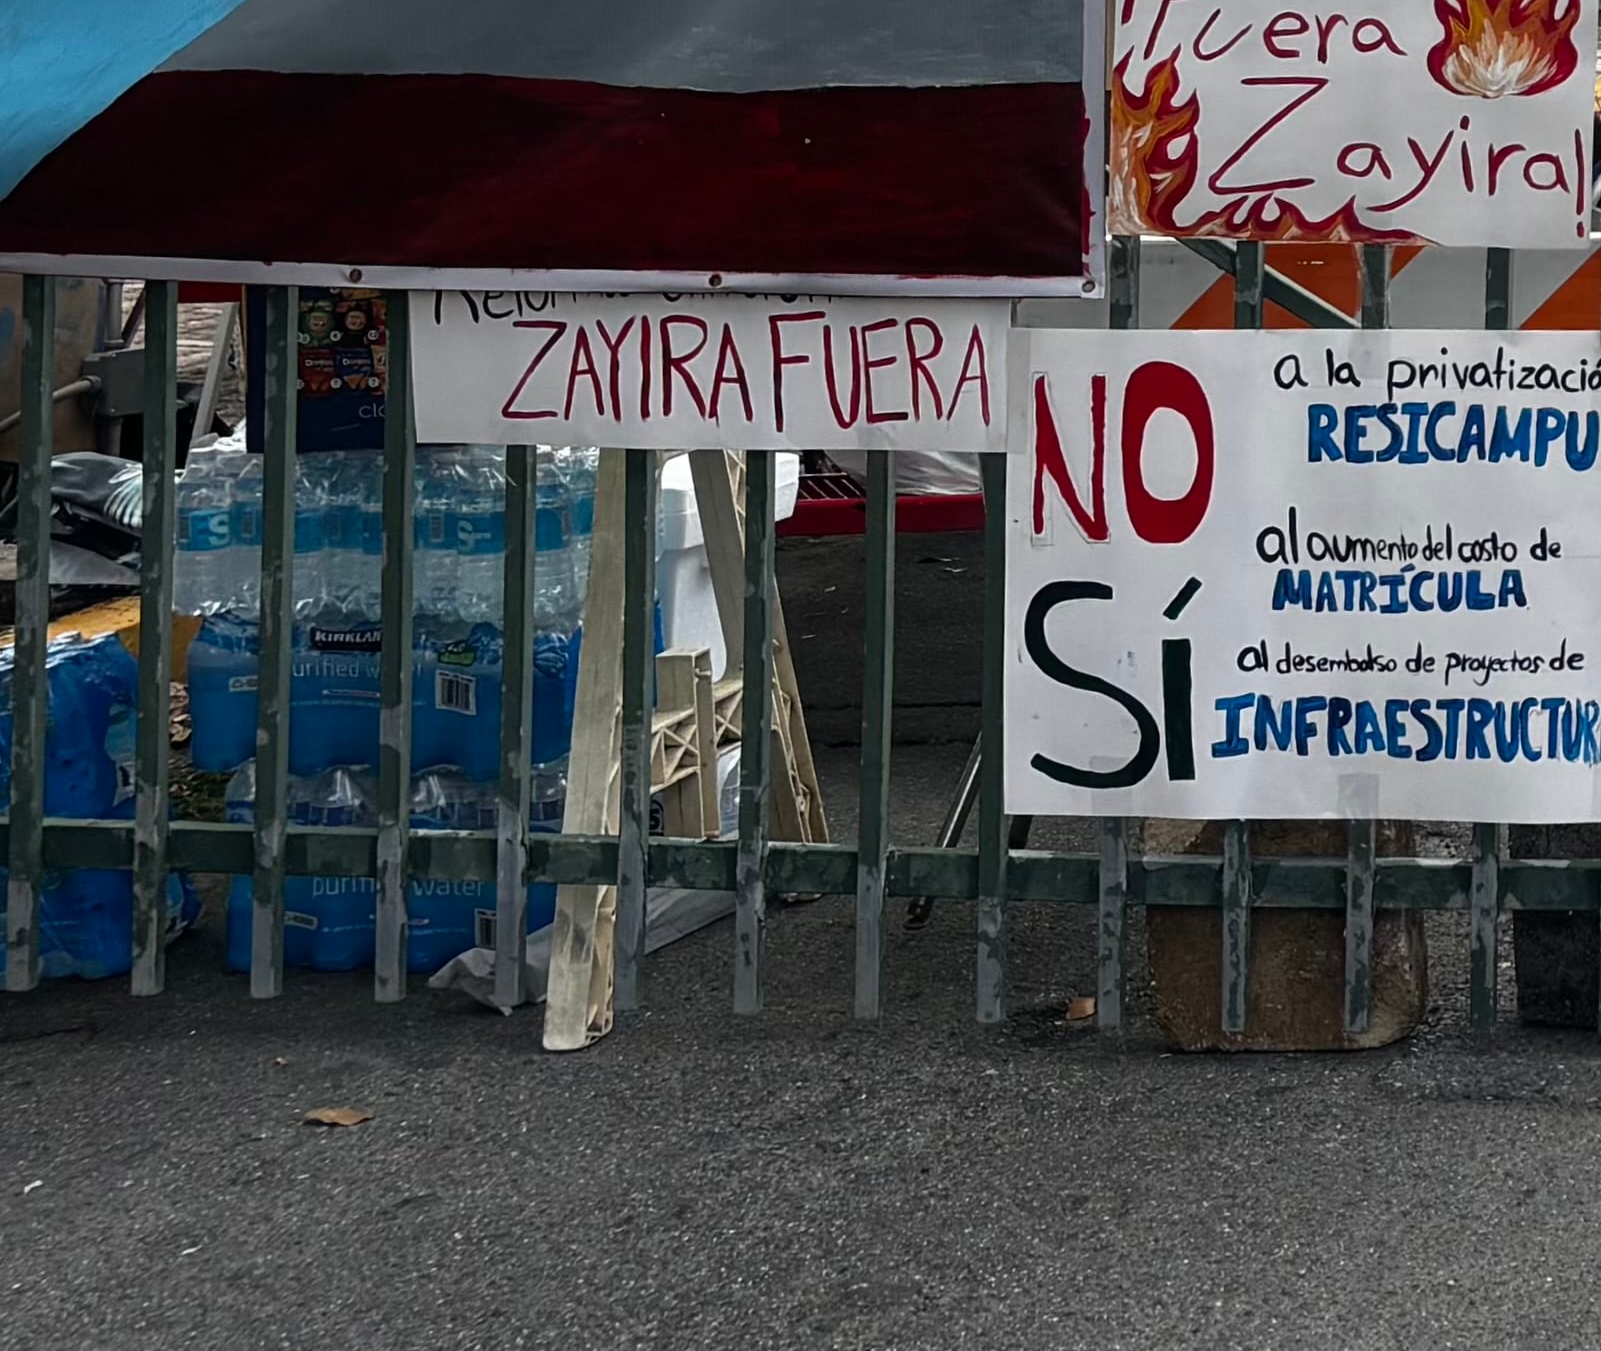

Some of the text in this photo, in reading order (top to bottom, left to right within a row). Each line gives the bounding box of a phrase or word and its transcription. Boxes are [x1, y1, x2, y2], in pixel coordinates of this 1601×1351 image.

[1208, 77, 1586, 238] Zayira!
[501, 310, 991, 432] ZAYIRA FUERA
[1273, 352, 1309, 390] a
[1327, 348, 1361, 388] la
[1032, 360, 1215, 545] NO
[1307, 402, 1600, 471] RESICAMPU
[1256, 506, 1562, 564] al aumento del costo de
[1272, 563, 1528, 614] MATRÍCULA
[292, 661, 360, 678] urified
[1024, 576, 1203, 789] SÍ
[1237, 639, 1268, 673] al
[1406, 641, 1436, 673] de
[1445, 650, 1545, 686] proyectos
[1549, 637, 1585, 672] de
